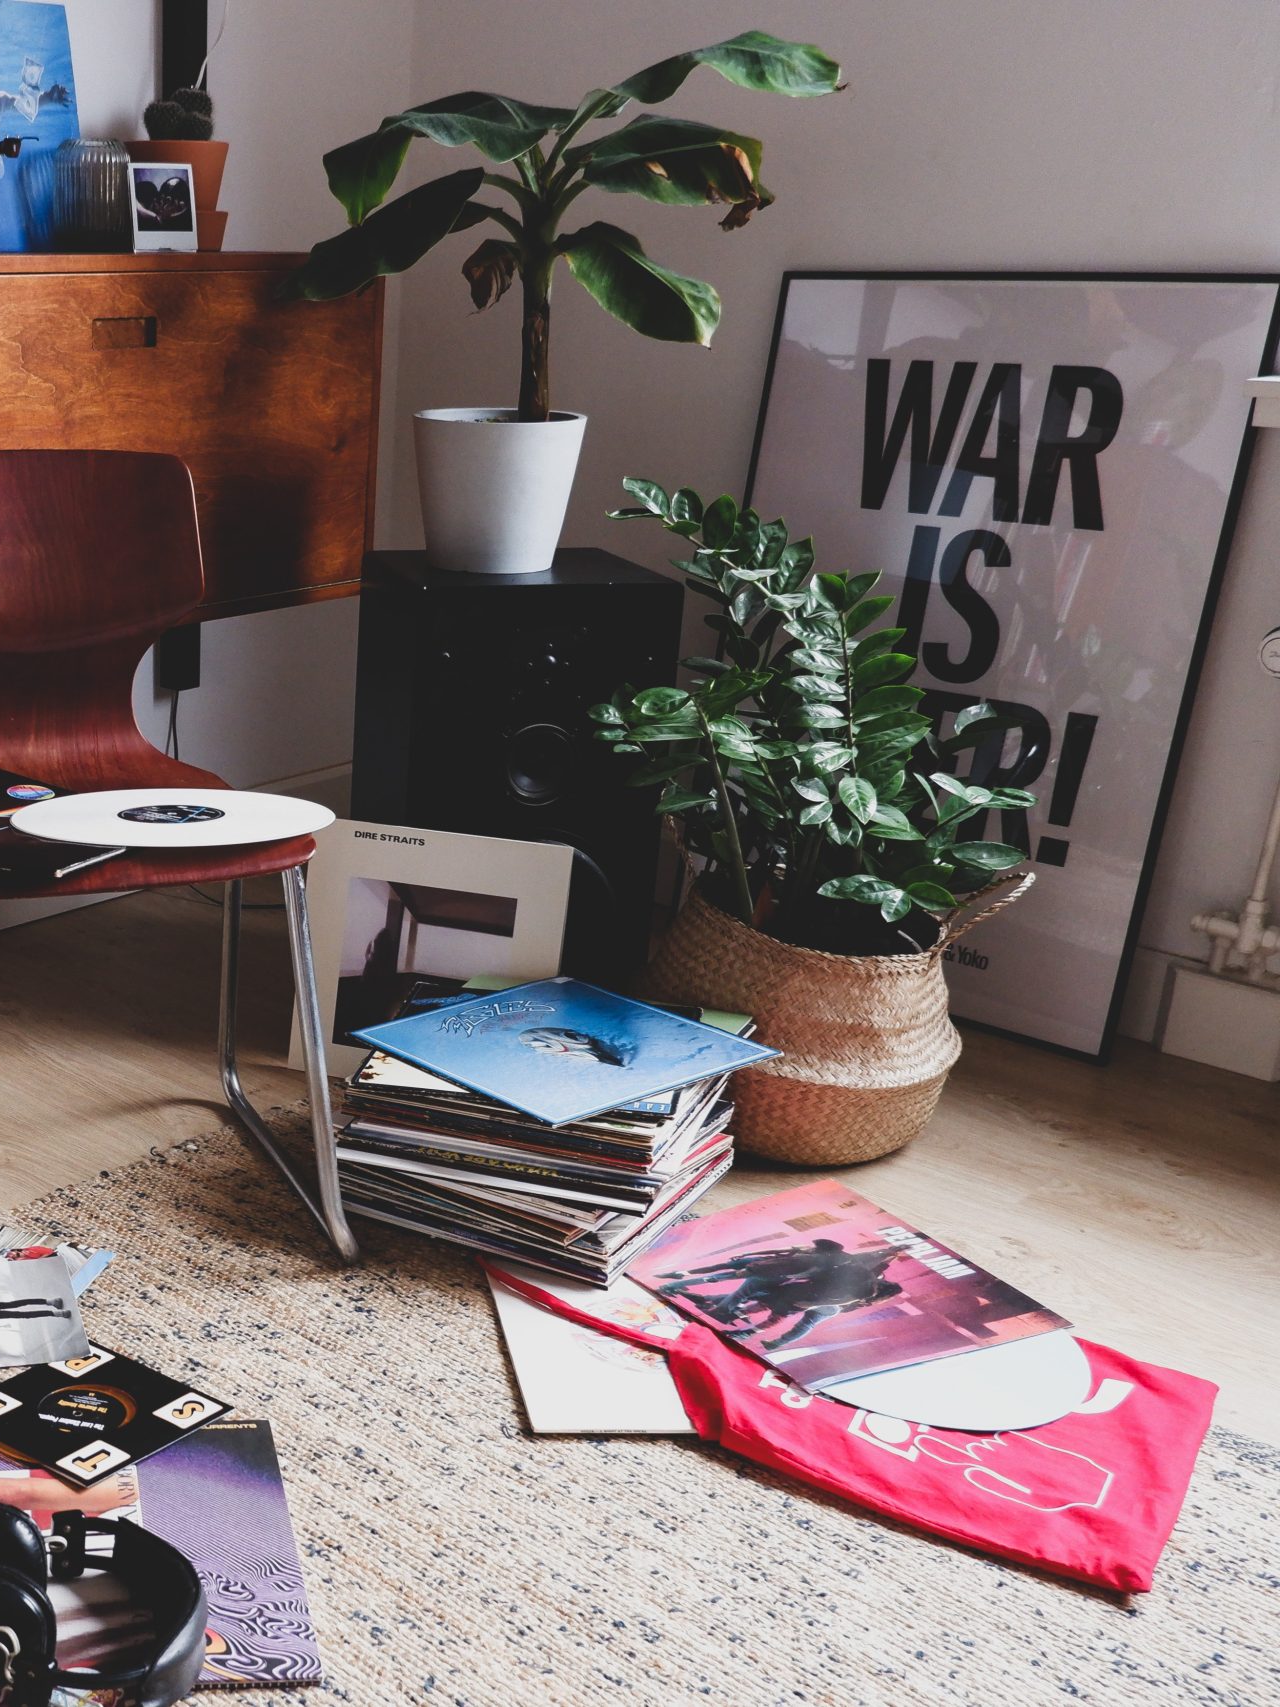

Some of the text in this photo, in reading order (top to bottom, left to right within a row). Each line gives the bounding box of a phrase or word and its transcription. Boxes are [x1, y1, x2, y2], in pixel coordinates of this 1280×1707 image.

[860, 357, 1124, 531] WAR
[898, 523, 1012, 684] IS
[354, 830, 426, 846] DIRE STRAITS
[957, 945, 989, 970] Yoko
[172, 1401, 205, 1419] S
